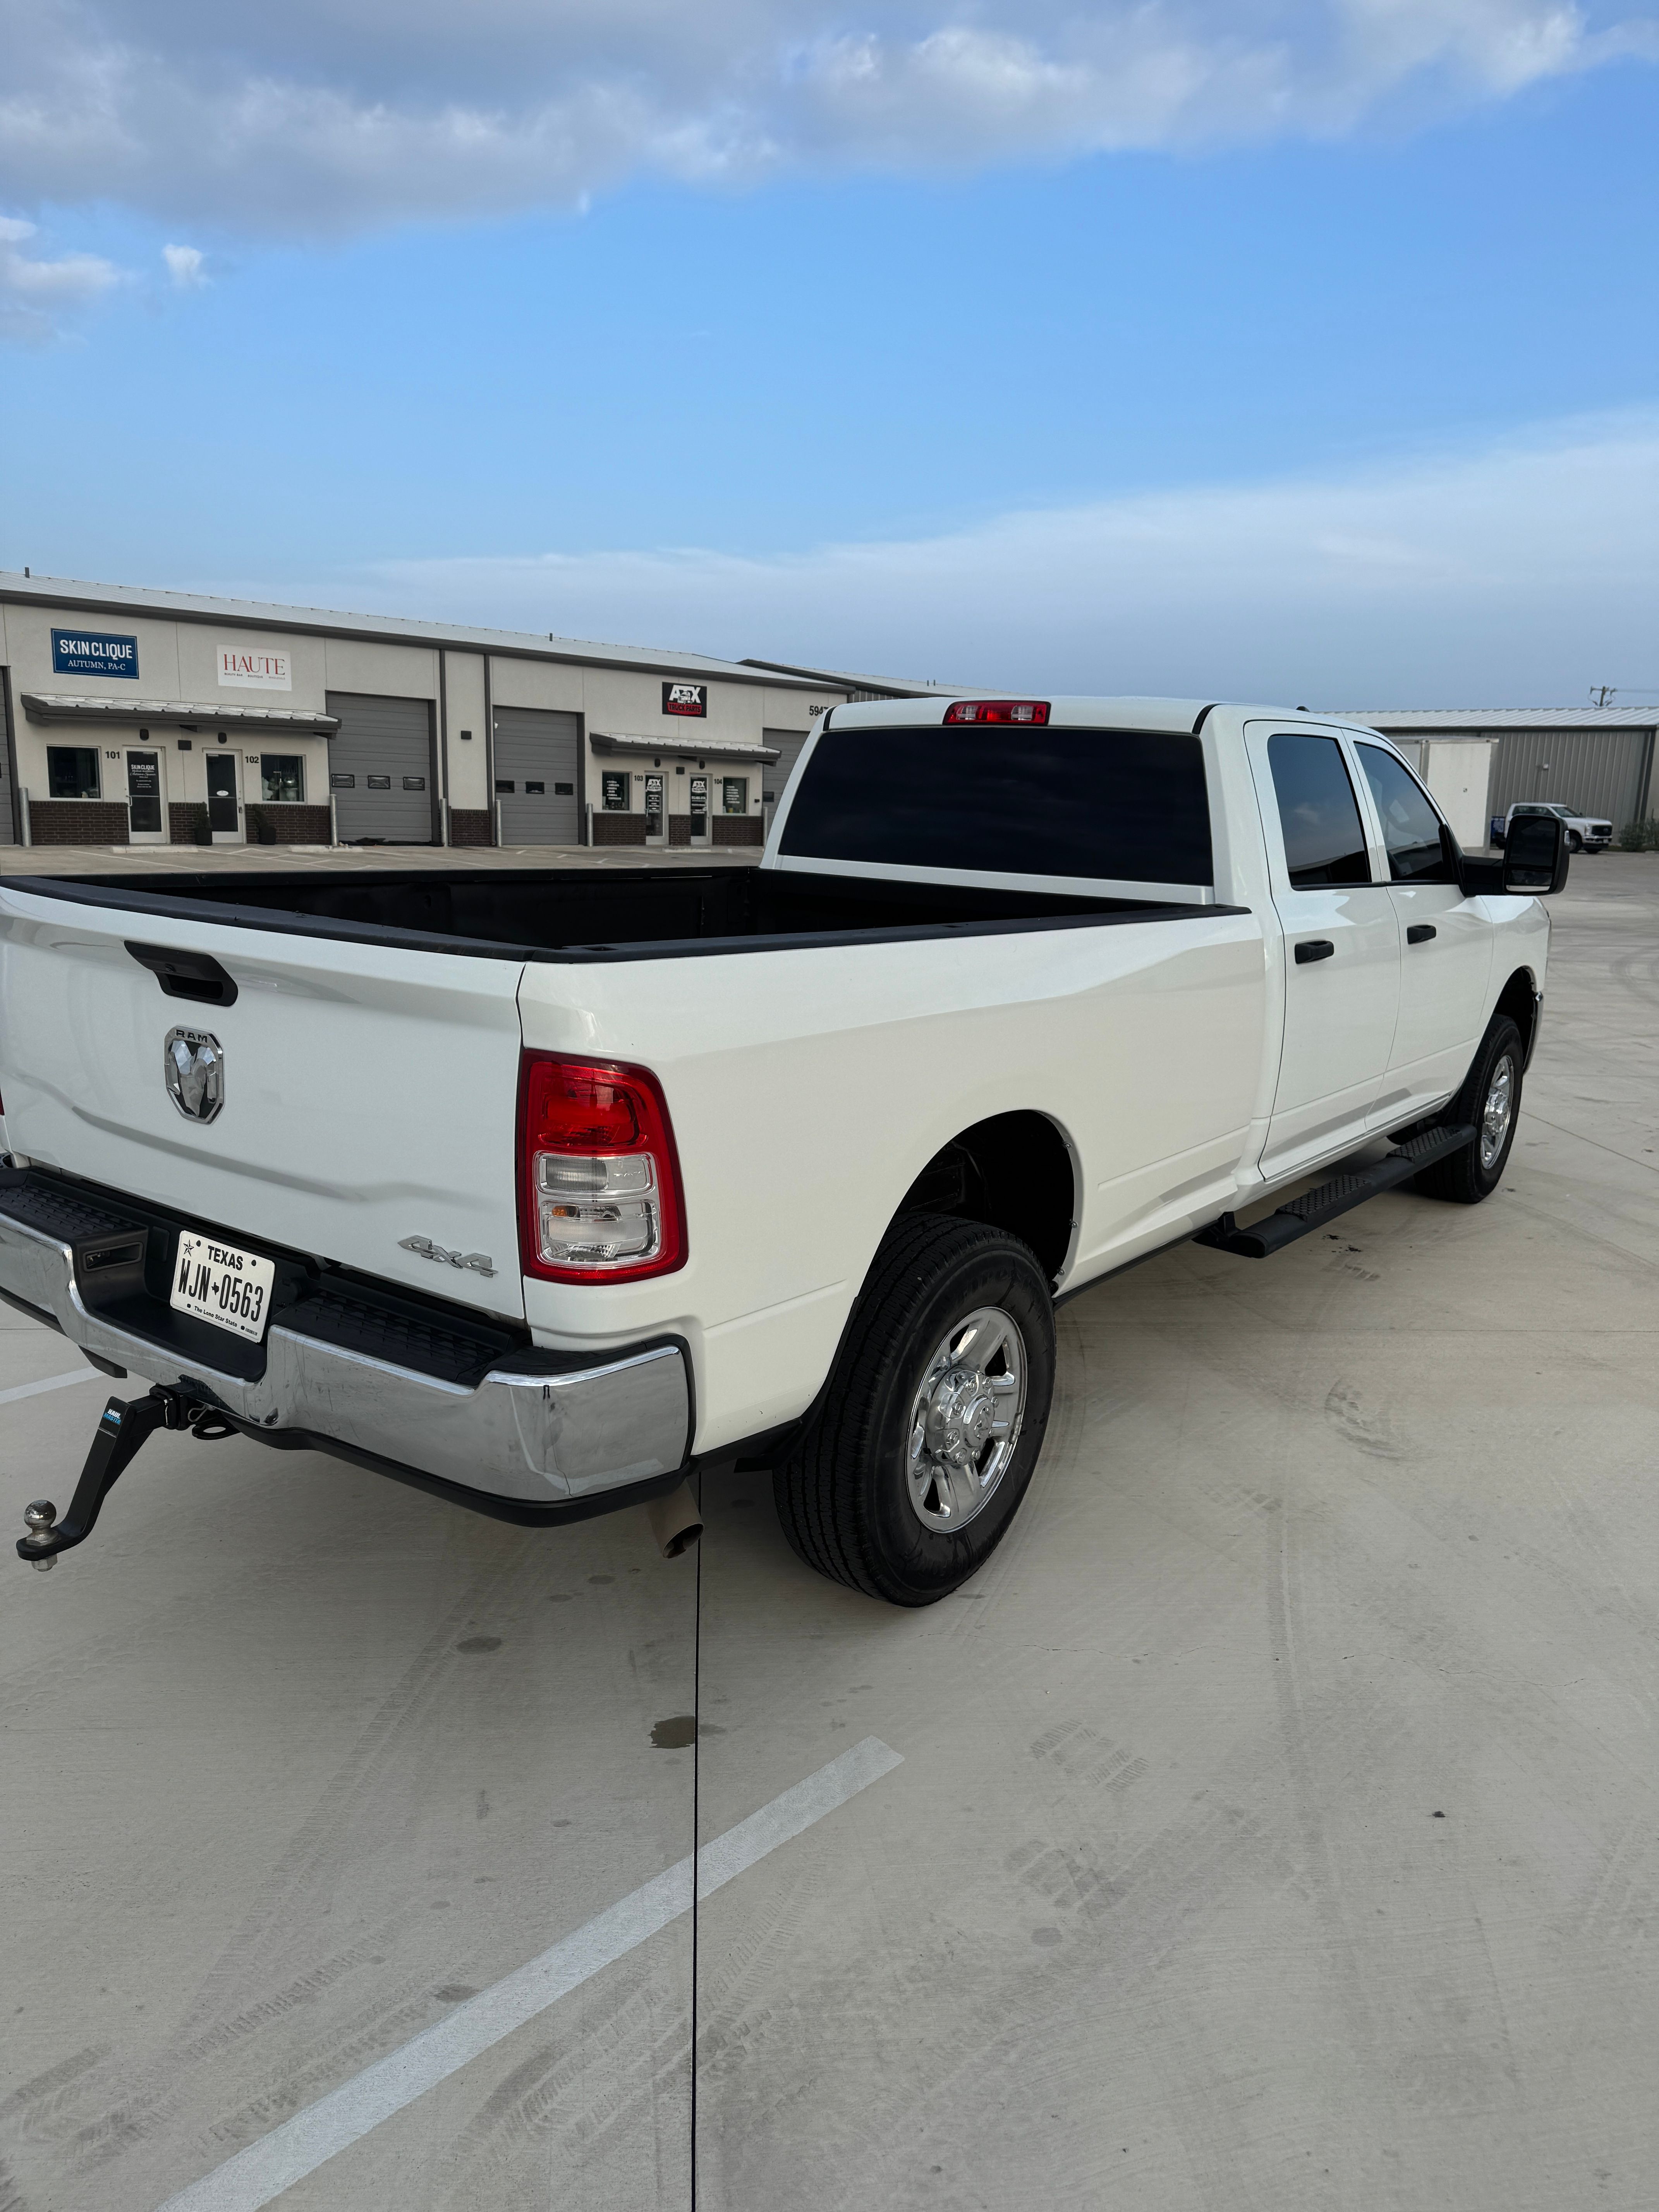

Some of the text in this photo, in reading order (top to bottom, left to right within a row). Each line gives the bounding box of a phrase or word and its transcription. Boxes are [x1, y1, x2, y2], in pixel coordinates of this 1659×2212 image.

[60, 639, 132, 660] SKIN CLIQUE
[68, 659, 106, 670] AUTUMN,
[224, 654, 285, 675] HAUTE
[669, 703, 685, 711] TRUCK
[809, 706, 829, 716] 594
[105, 751, 120, 759] 101
[175, 1029, 208, 1043] RAM
[208, 1245, 243, 1271] TEXAS
[203, 1309, 214, 1318] Lone
[225, 1318, 237, 1327] State
[103, 1413, 121, 1425] MASTER
[107, 1408, 120, 1419] HAUL
